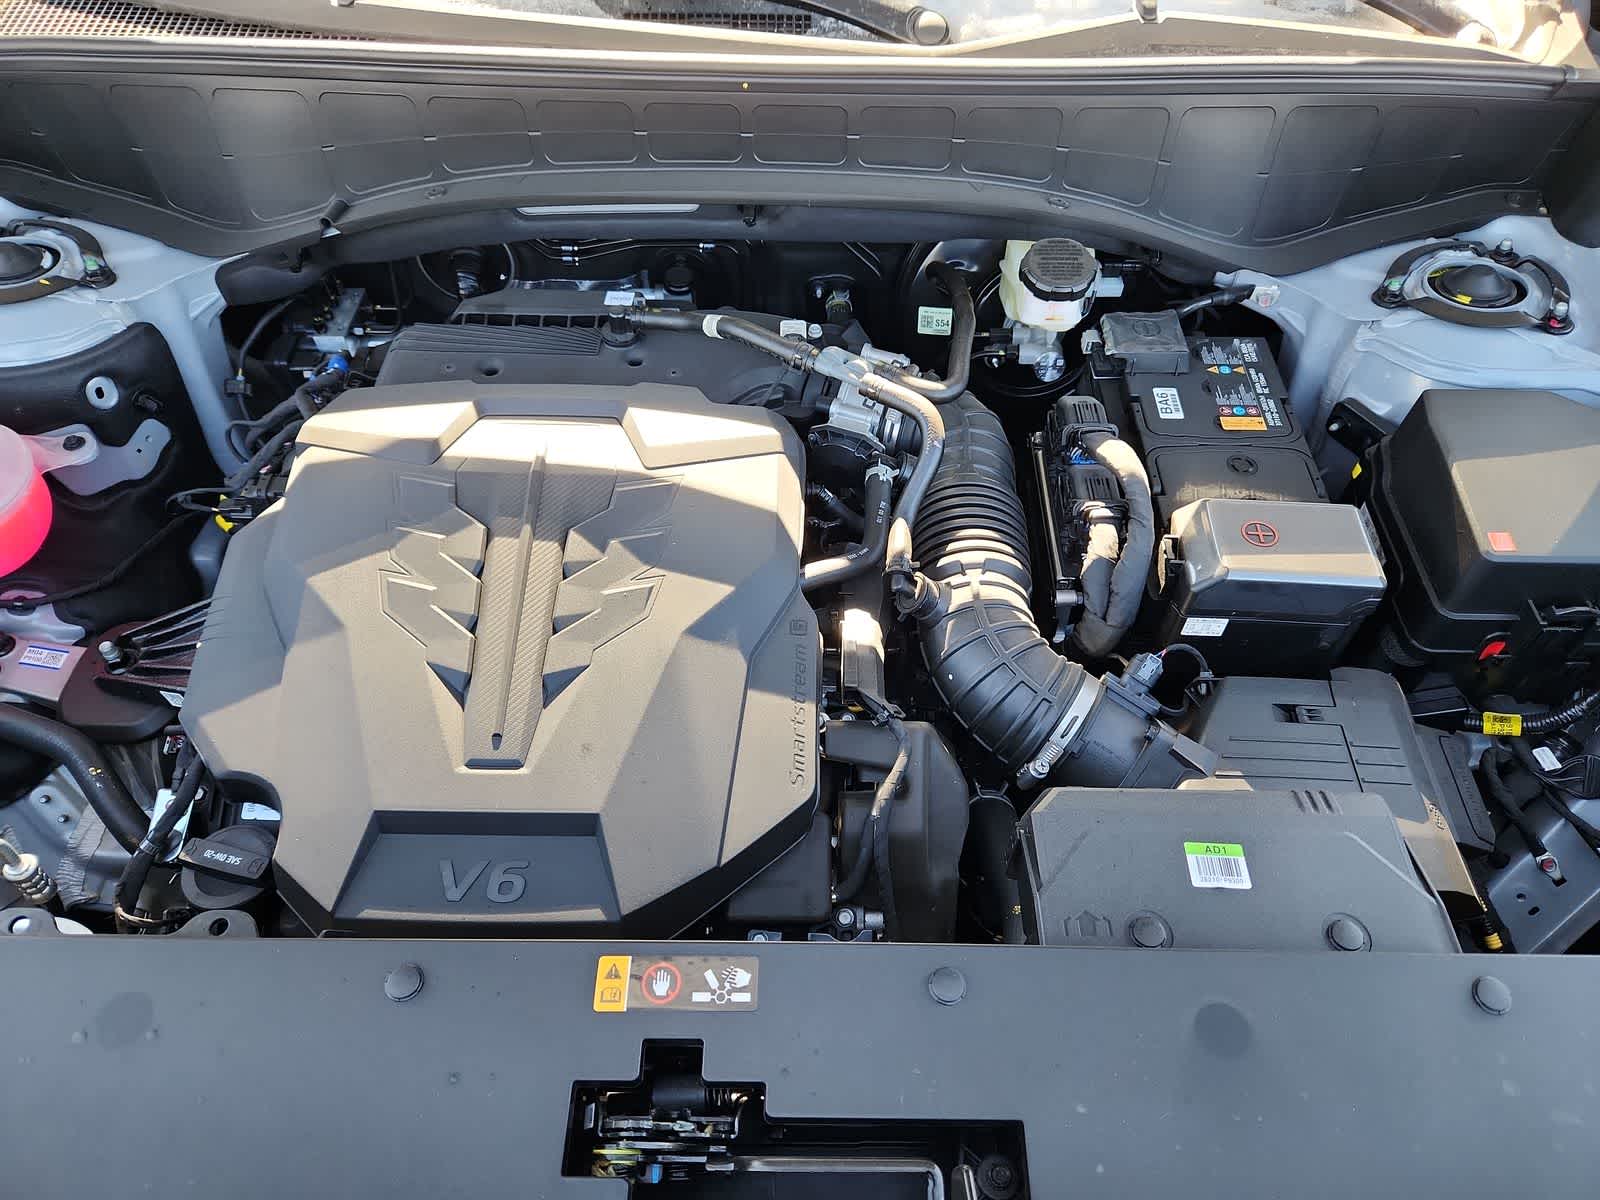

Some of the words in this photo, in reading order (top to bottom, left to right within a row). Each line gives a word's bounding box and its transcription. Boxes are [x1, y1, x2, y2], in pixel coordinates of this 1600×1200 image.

[935, 318, 950, 328] S54
[1157, 392, 1173, 414] BA6
[790, 644, 807, 785] Smartstream
[203, 849, 228, 861] 0W-20
[1205, 845, 1227, 855] AD1
[226, 855, 242, 865] SAE
[439, 859, 533, 903] V6
